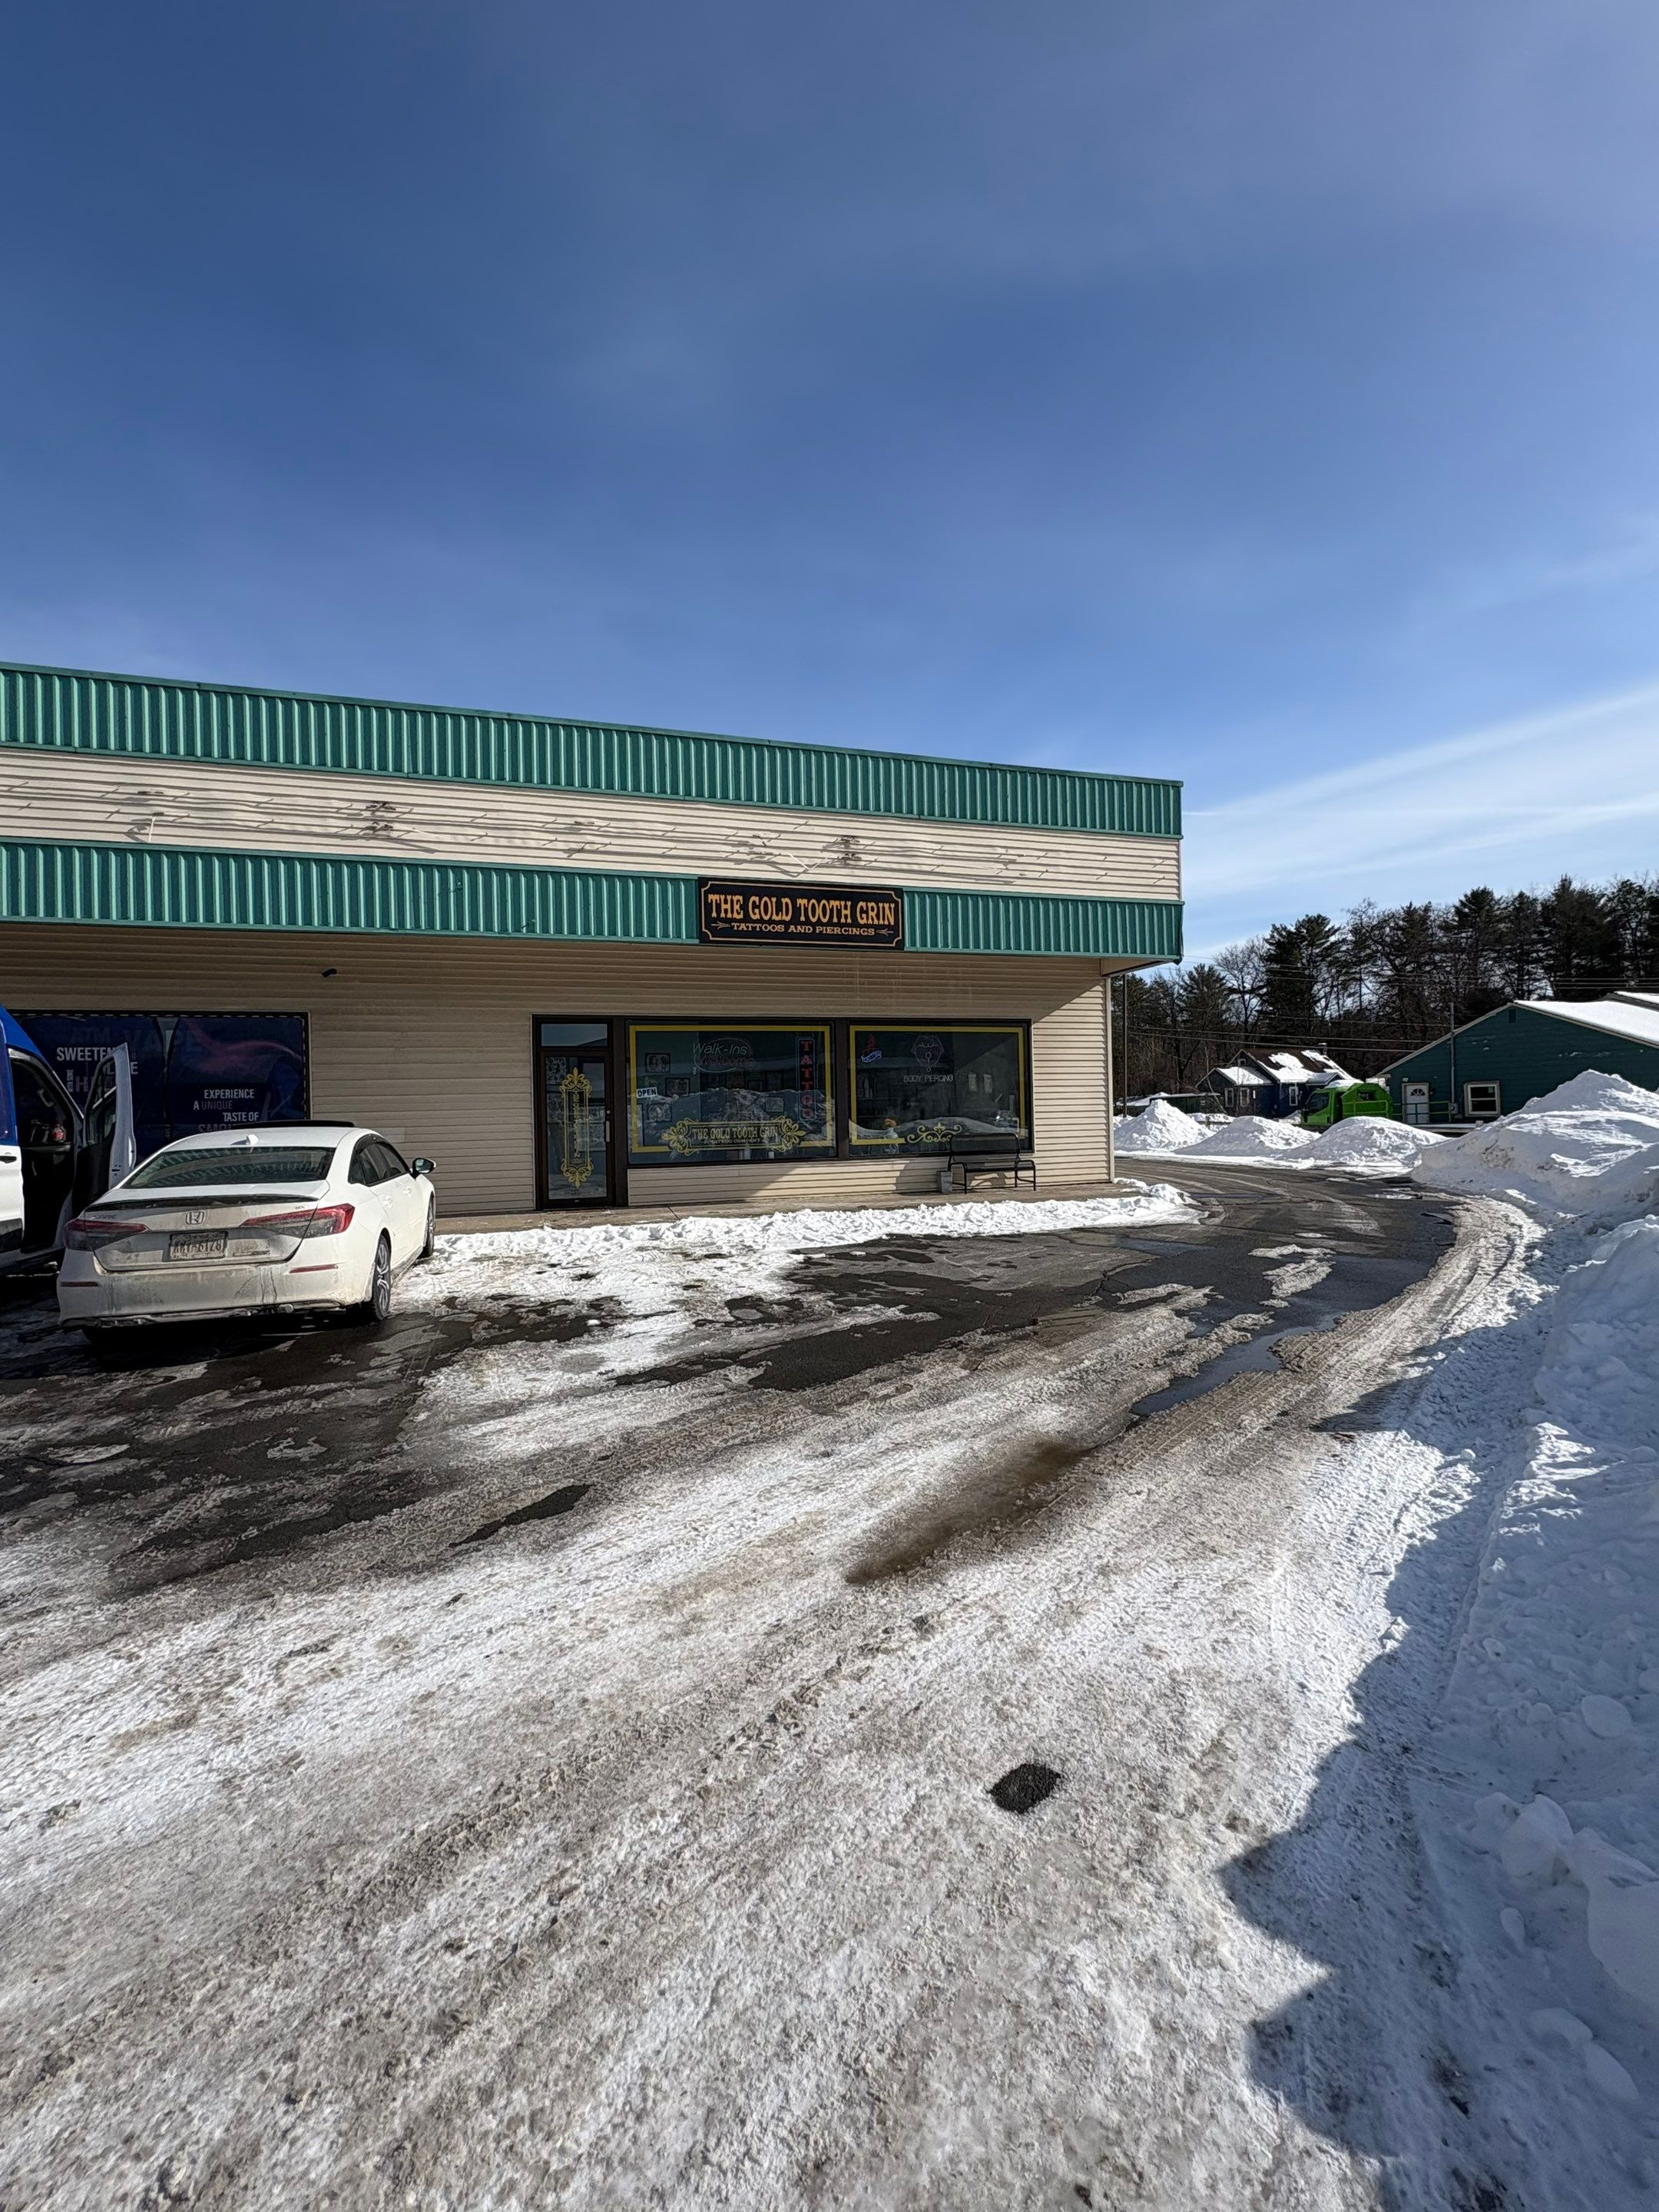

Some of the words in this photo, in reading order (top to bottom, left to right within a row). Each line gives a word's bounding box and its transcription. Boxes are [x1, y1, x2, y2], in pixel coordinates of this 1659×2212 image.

[708, 893, 743, 919] THE
[748, 896, 793, 922] GOLD
[796, 898, 852, 924] TOOTH
[856, 901, 896, 926] GRIN
[731, 922, 785, 932] TATTOOS
[788, 924, 813, 934] AND
[816, 926, 875, 936] PIERCINGS
[693, 1042, 748, 1055] Walk-Ins
[903, 1075, 922, 1083] BODY
[204, 1088, 255, 1099] EXPERIENCE
[637, 1088, 656, 1097] OPEN
[193, 1101, 200, 1111] A
[201, 1101, 233, 1111] UNIQUE
[222, 1111, 247, 1122] TASTE
[248, 1111, 260, 1122] OF
[692, 1128, 708, 1140] THE
[732, 1126, 758, 1138] TOOTH
